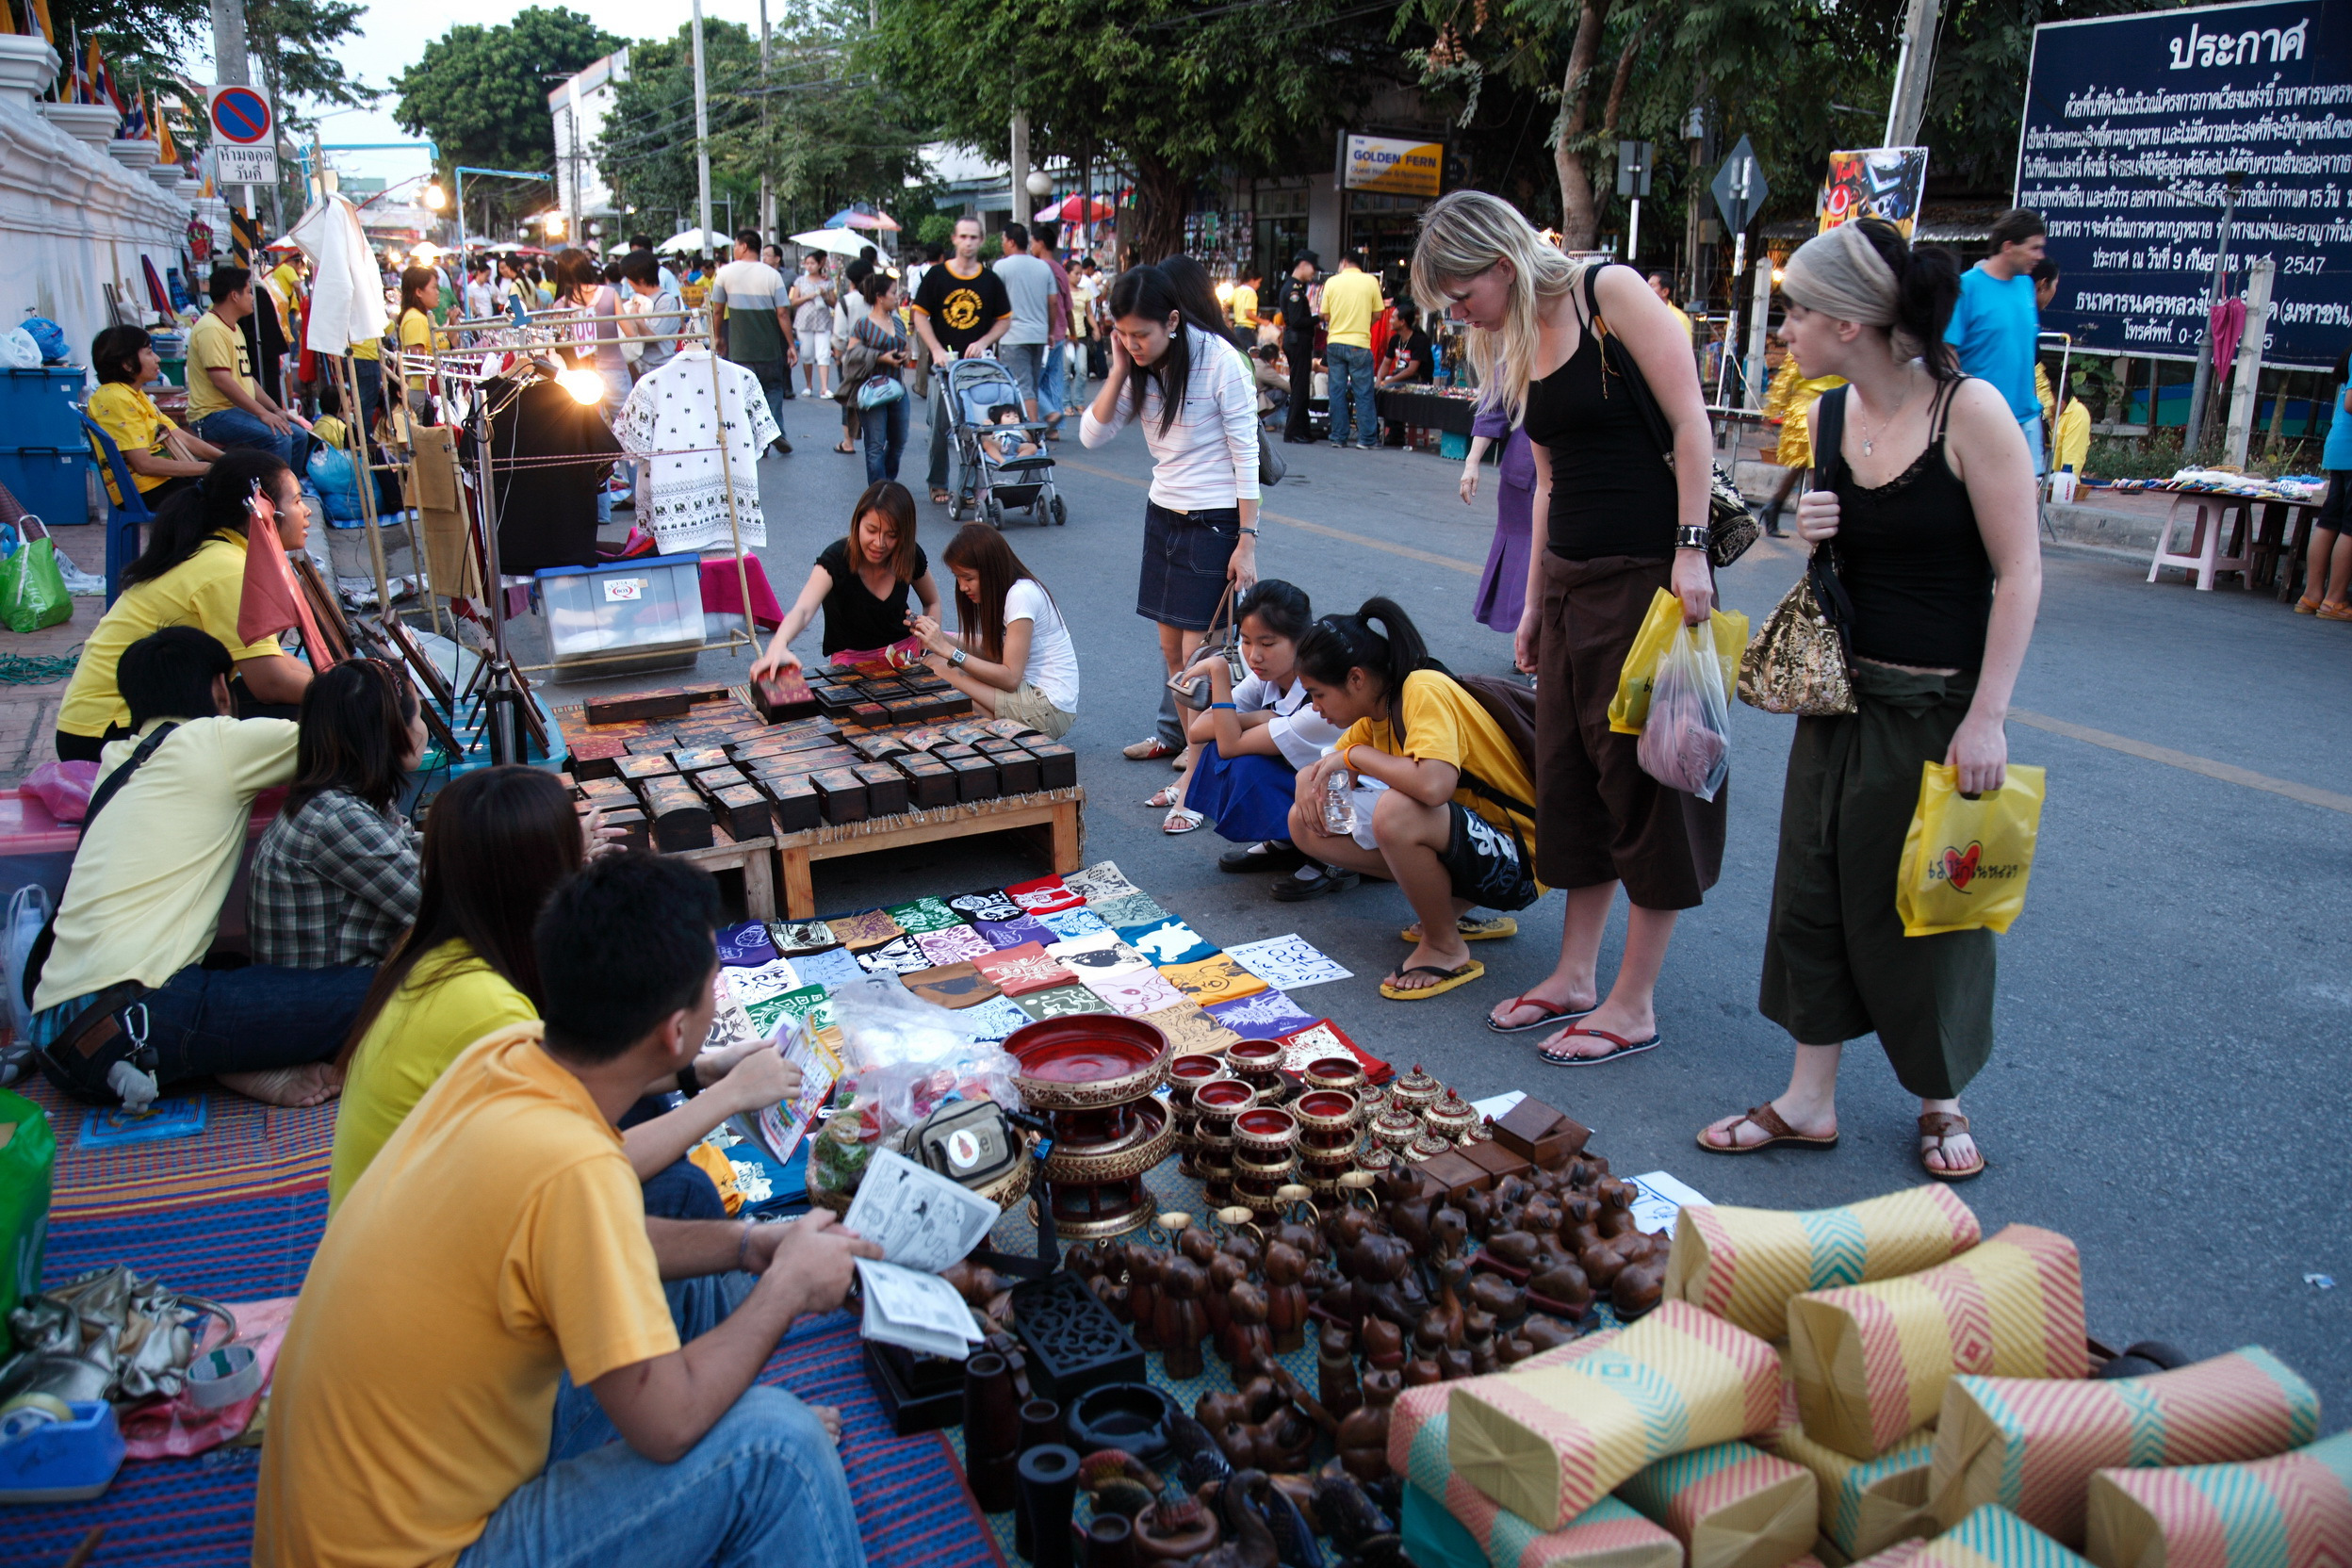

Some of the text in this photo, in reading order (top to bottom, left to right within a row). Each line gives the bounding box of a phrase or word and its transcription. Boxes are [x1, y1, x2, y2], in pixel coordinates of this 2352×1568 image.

[2169, 18, 2310, 71] ประกาศ
[220, 145, 272, 162] ห้ามจอด
[1354, 150, 1436, 168] GOLDEN FERN
[1372, 168, 1392, 177] House
[2309, 188, 2323, 208] 15
[2324, 182, 2341, 208] วัน
[2092, 246, 2130, 270] ประกาศ
[2132, 252, 2144, 270] ณ
[2148, 242, 2171, 270] วันที่
[2172, 252, 2181, 270] 9
[2283, 256, 2327, 275] 2547
